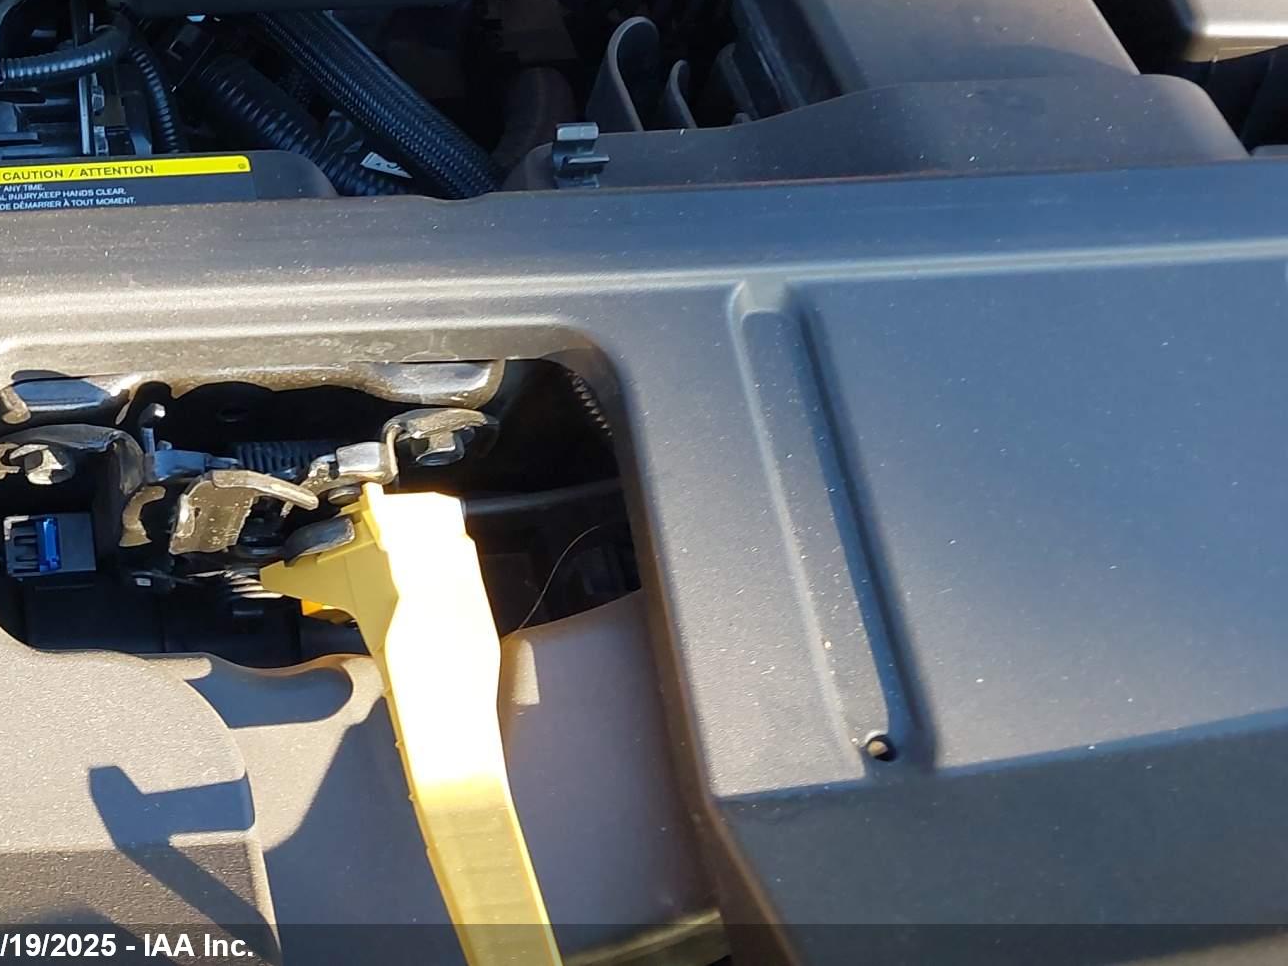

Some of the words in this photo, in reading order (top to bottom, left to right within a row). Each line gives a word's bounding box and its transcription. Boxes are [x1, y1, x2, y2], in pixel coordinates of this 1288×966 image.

[2, 168, 64, 181] CAUTION
[79, 164, 154, 178] ATTENTION
[3, 184, 20, 194] ANY
[22, 183, 45, 192] TIME.
[62, 188, 94, 198] HANDS
[95, 187, 127, 197] CLEAR.
[0, 201, 12, 212] DE
[13, 199, 62, 211] DÉMARRER
[71, 197, 94, 207] TOUT
[95, 196, 137, 207] MOMENT.
